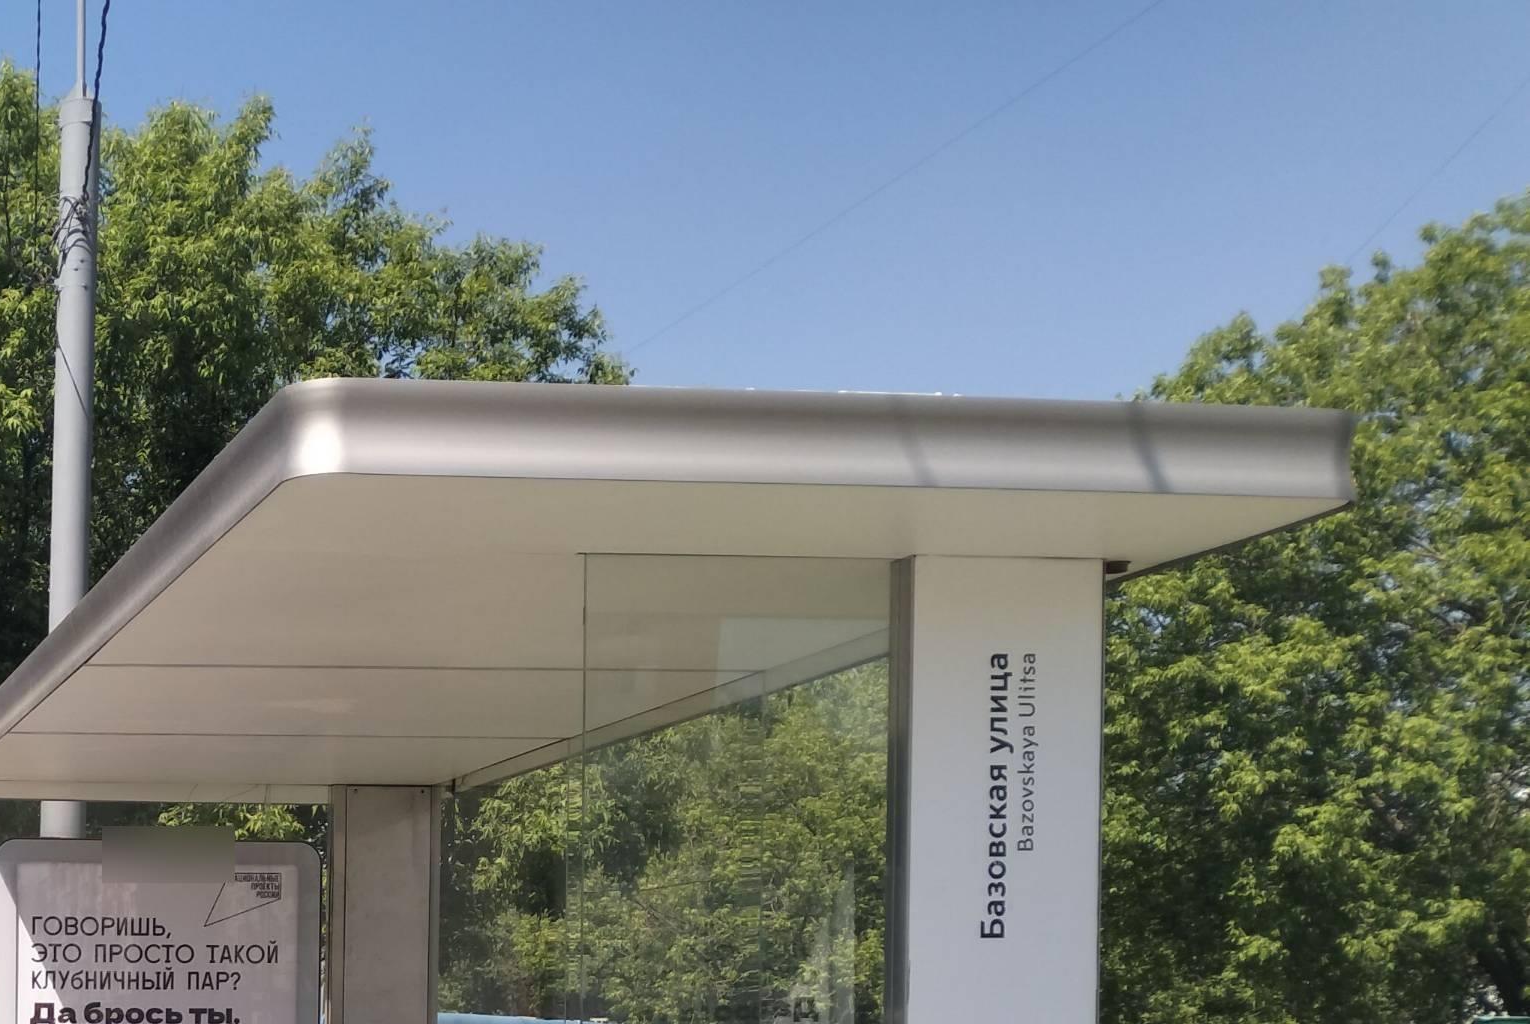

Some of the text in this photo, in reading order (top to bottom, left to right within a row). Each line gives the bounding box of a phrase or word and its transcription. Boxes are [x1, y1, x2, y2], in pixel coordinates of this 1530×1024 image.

[1016, 653, 1039, 852] Bazovskaya Ulitsa
[980, 652, 1014, 940] Базовская улица
[31, 916, 172, 939] ГОВОРИШЬ,
[31, 940, 279, 964] ЭТО ПРОСТО ТАКОЙ
[187, 971, 241, 991] ПАР?
[189, 1007, 240, 1024] ты.
